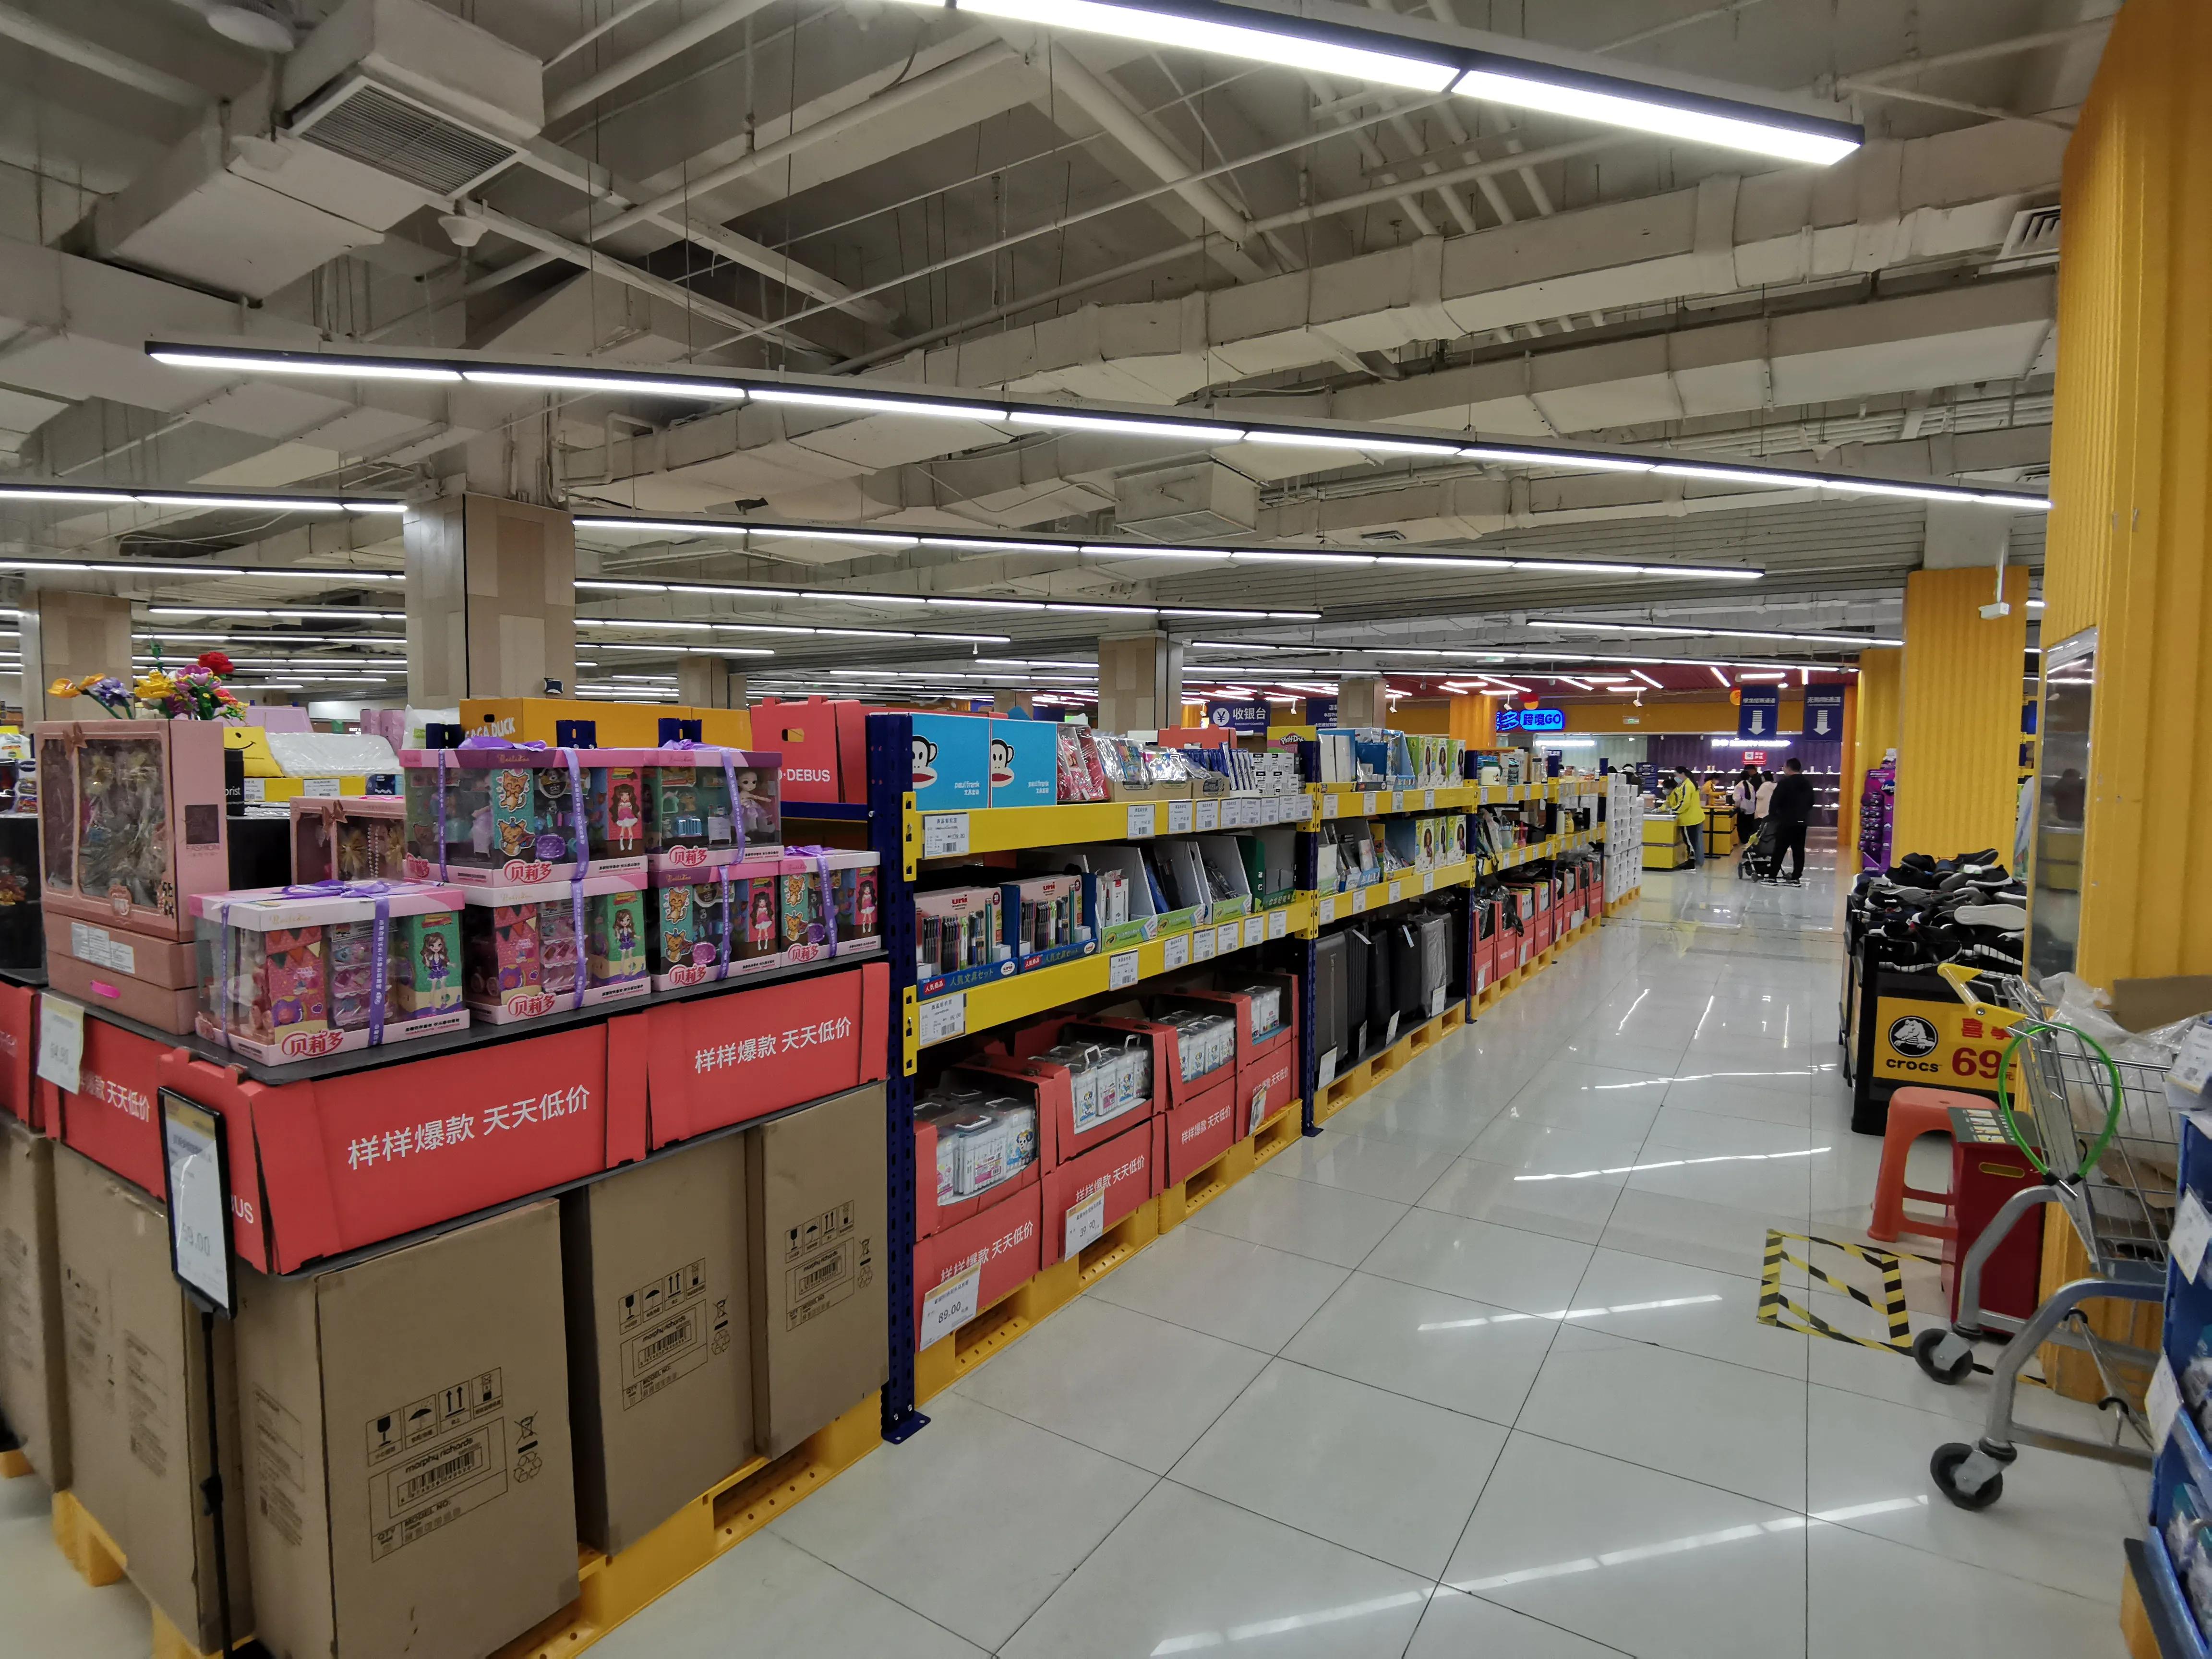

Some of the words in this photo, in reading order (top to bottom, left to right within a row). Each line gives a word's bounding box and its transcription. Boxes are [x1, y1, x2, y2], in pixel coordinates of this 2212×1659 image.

[1233, 707, 1266, 720] 收银台
[1523, 713, 1561, 726] 跨境GO
[509, 862, 552, 882] 贝莉多
[951, 894, 968, 905] uni
[512, 994, 555, 1016] 贝莉多
[287, 1031, 343, 1056] 贝莉多
[695, 1034, 776, 1074] 样样爆款
[781, 1015, 852, 1053] 天天低价
[1886, 1058, 1939, 1072] crocs
[107, 1080, 150, 1122] 天天低价
[348, 1113, 475, 1171] 样样爆款
[483, 1083, 590, 1136] 天天低价
[1181, 1119, 1207, 1145] 样样爆款
[1208, 1105, 1231, 1130] 天天低价
[1112, 1154, 1145, 1184] 天天低价
[992, 1220, 1034, 1259] 天天低价
[938, 1301, 961, 1323] 89.00
[642, 1328, 664, 1343] morphy
[663, 1315, 686, 1331] richards
[405, 1453, 439, 1473] morphy
[439, 1437, 474, 1458] richards
[377, 1526, 396, 1541] QTY
